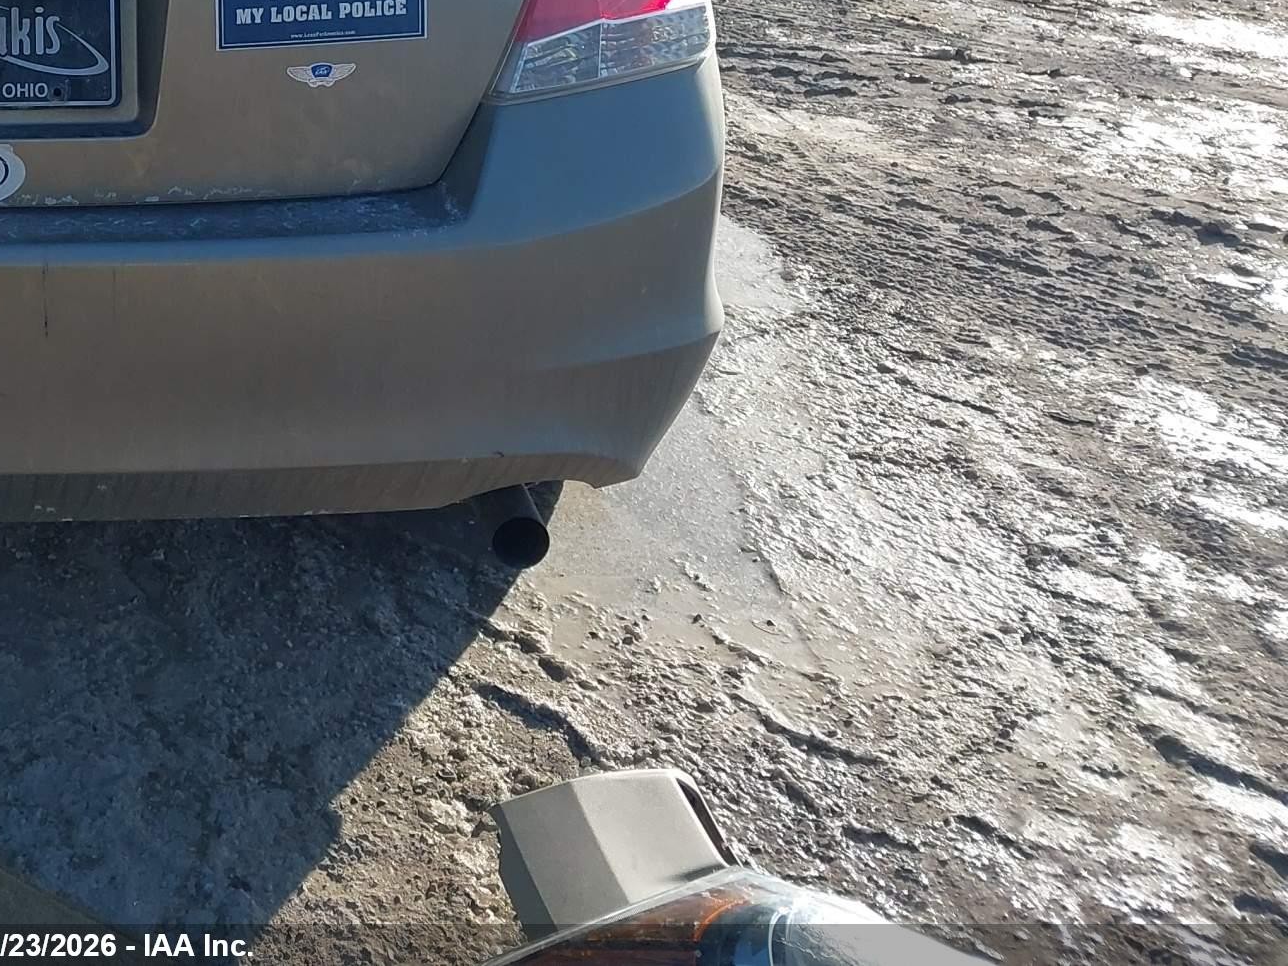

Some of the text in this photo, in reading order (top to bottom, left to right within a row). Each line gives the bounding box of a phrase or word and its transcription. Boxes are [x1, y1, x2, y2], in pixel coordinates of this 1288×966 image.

[236, 8, 264, 25] MY
[270, 4, 332, 23] LOCAL
[2, 83, 49, 99] OHIO
